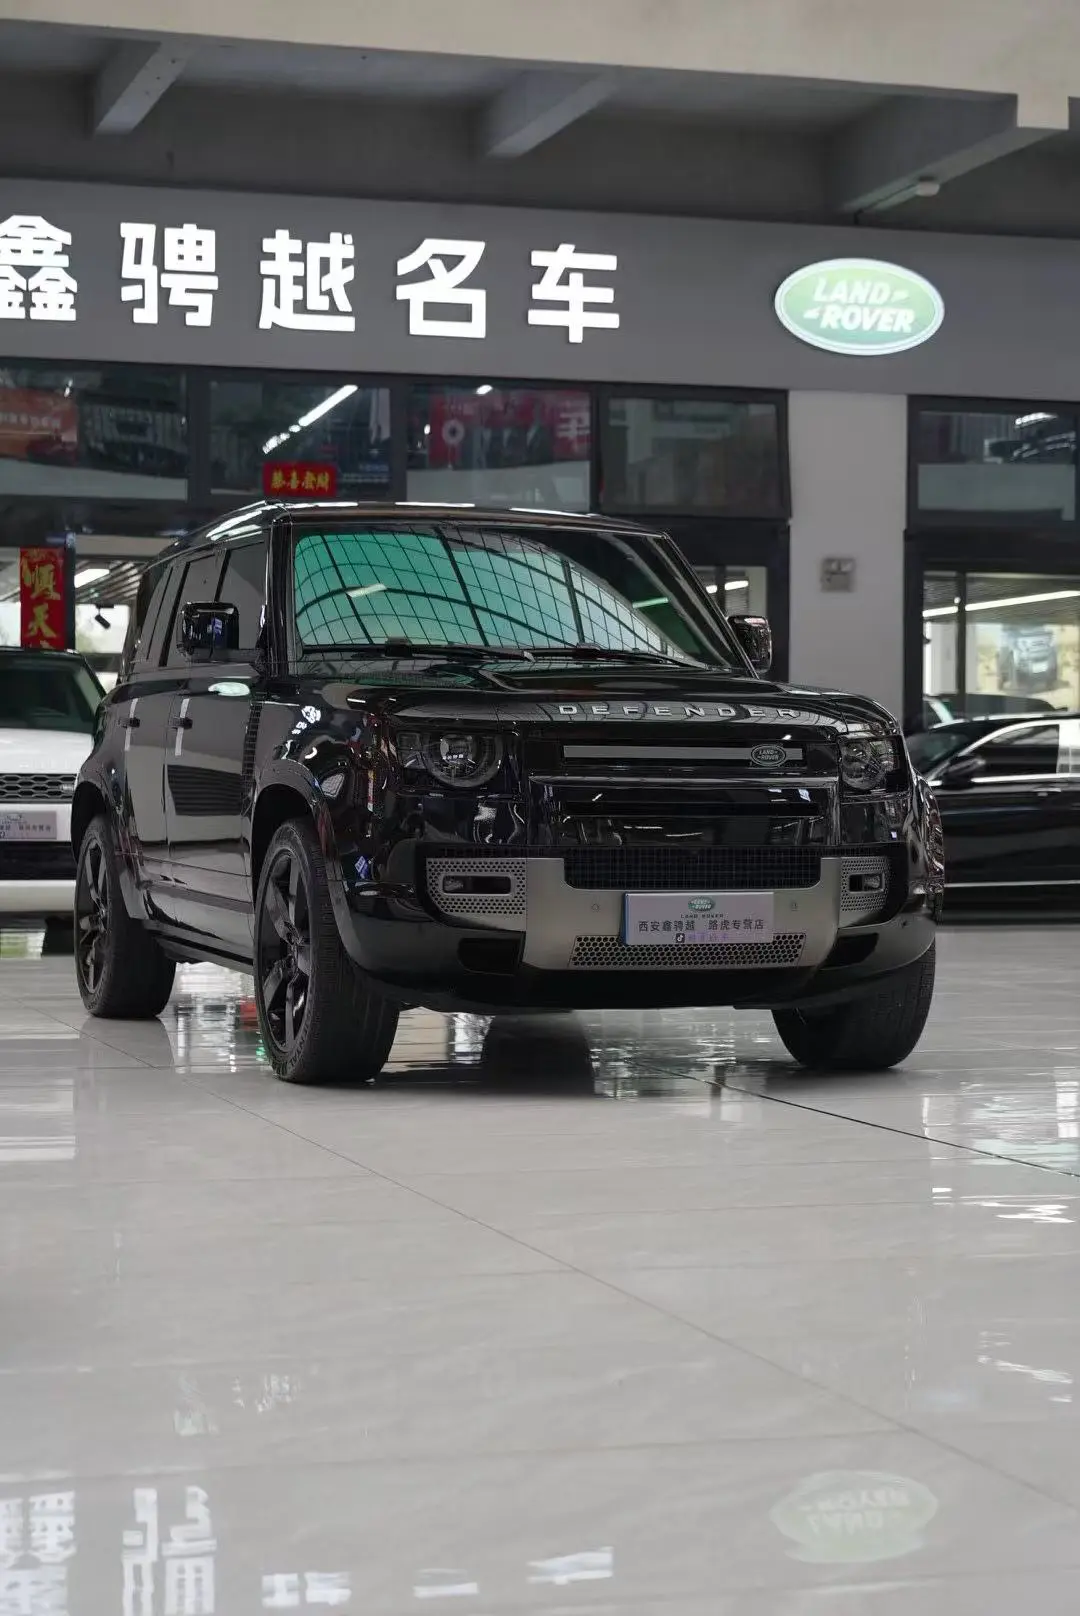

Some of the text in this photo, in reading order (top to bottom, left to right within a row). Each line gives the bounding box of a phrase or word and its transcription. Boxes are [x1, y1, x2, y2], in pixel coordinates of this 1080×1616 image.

[0, 214, 620, 343] 鑫骋越名车
[814, 279, 890, 305] LAND
[820, 306, 915, 333] ROVER
[558, 704, 803, 718] DEFENDER
[708, 919, 764, 931] 路虎专营店
